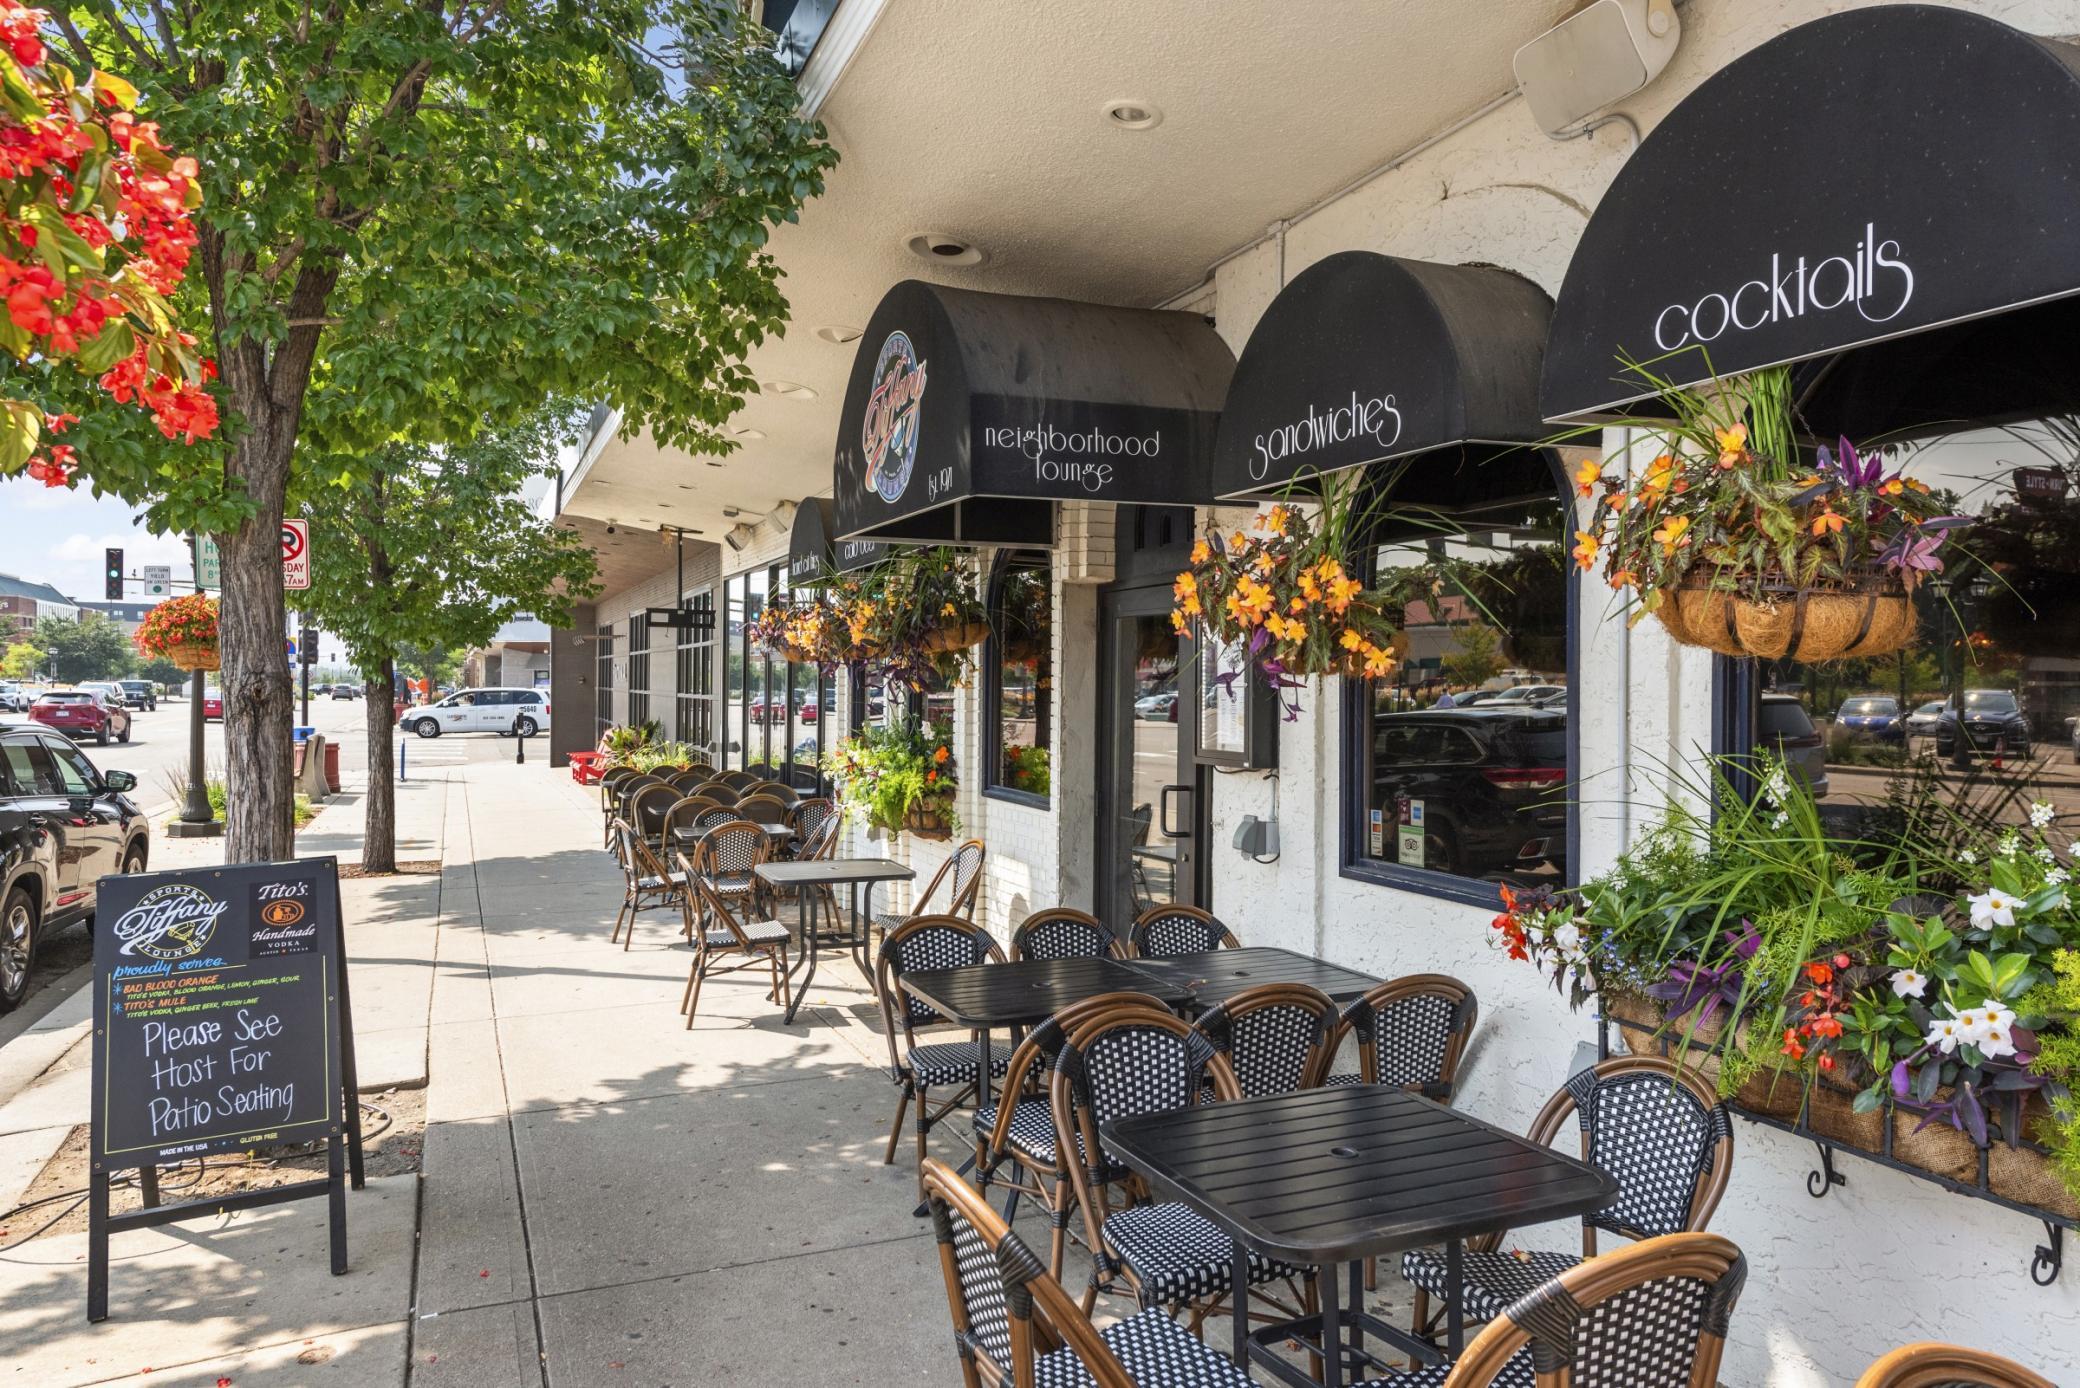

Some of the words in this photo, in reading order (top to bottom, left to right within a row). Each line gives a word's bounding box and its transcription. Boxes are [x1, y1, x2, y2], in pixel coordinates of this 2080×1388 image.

[1655, 222, 1914, 351] cocktails
[985, 423, 1160, 459] neighborhood
[1249, 391, 1401, 480] sandwiches
[1036, 452, 1113, 492] lounge
[148, 886, 198, 901] SPORTS
[257, 881, 308, 900] Tito's
[113, 895, 229, 955] Tiffany
[251, 923, 316, 942] Handmade
[144, 940, 202, 958] LOUNGE
[267, 941, 300, 949] VODKA
[113, 960, 172, 981] proudly
[123, 984, 143, 994] BAD
[145, 980, 177, 992] BLOOD
[178, 974, 220, 988] ORANGE
[173, 987, 197, 996] BLOOD
[124, 1000, 155, 1011] TITO'S
[158, 996, 187, 1008] MULE
[143, 1022, 222, 1057] Please
[234, 1009, 283, 1041] See
[151, 1054, 218, 1090] Host
[230, 1045, 271, 1075] For
[148, 1096, 211, 1137] Patio
[216, 1083, 294, 1122] Seating
[240, 1134, 263, 1144] GLUTEN
[263, 1132, 279, 1141] FREE
[160, 1147, 177, 1157] MADE
[177, 1145, 184, 1154] IN
[184, 1144, 195, 1153] THE
[195, 1142, 208, 1151] USA
